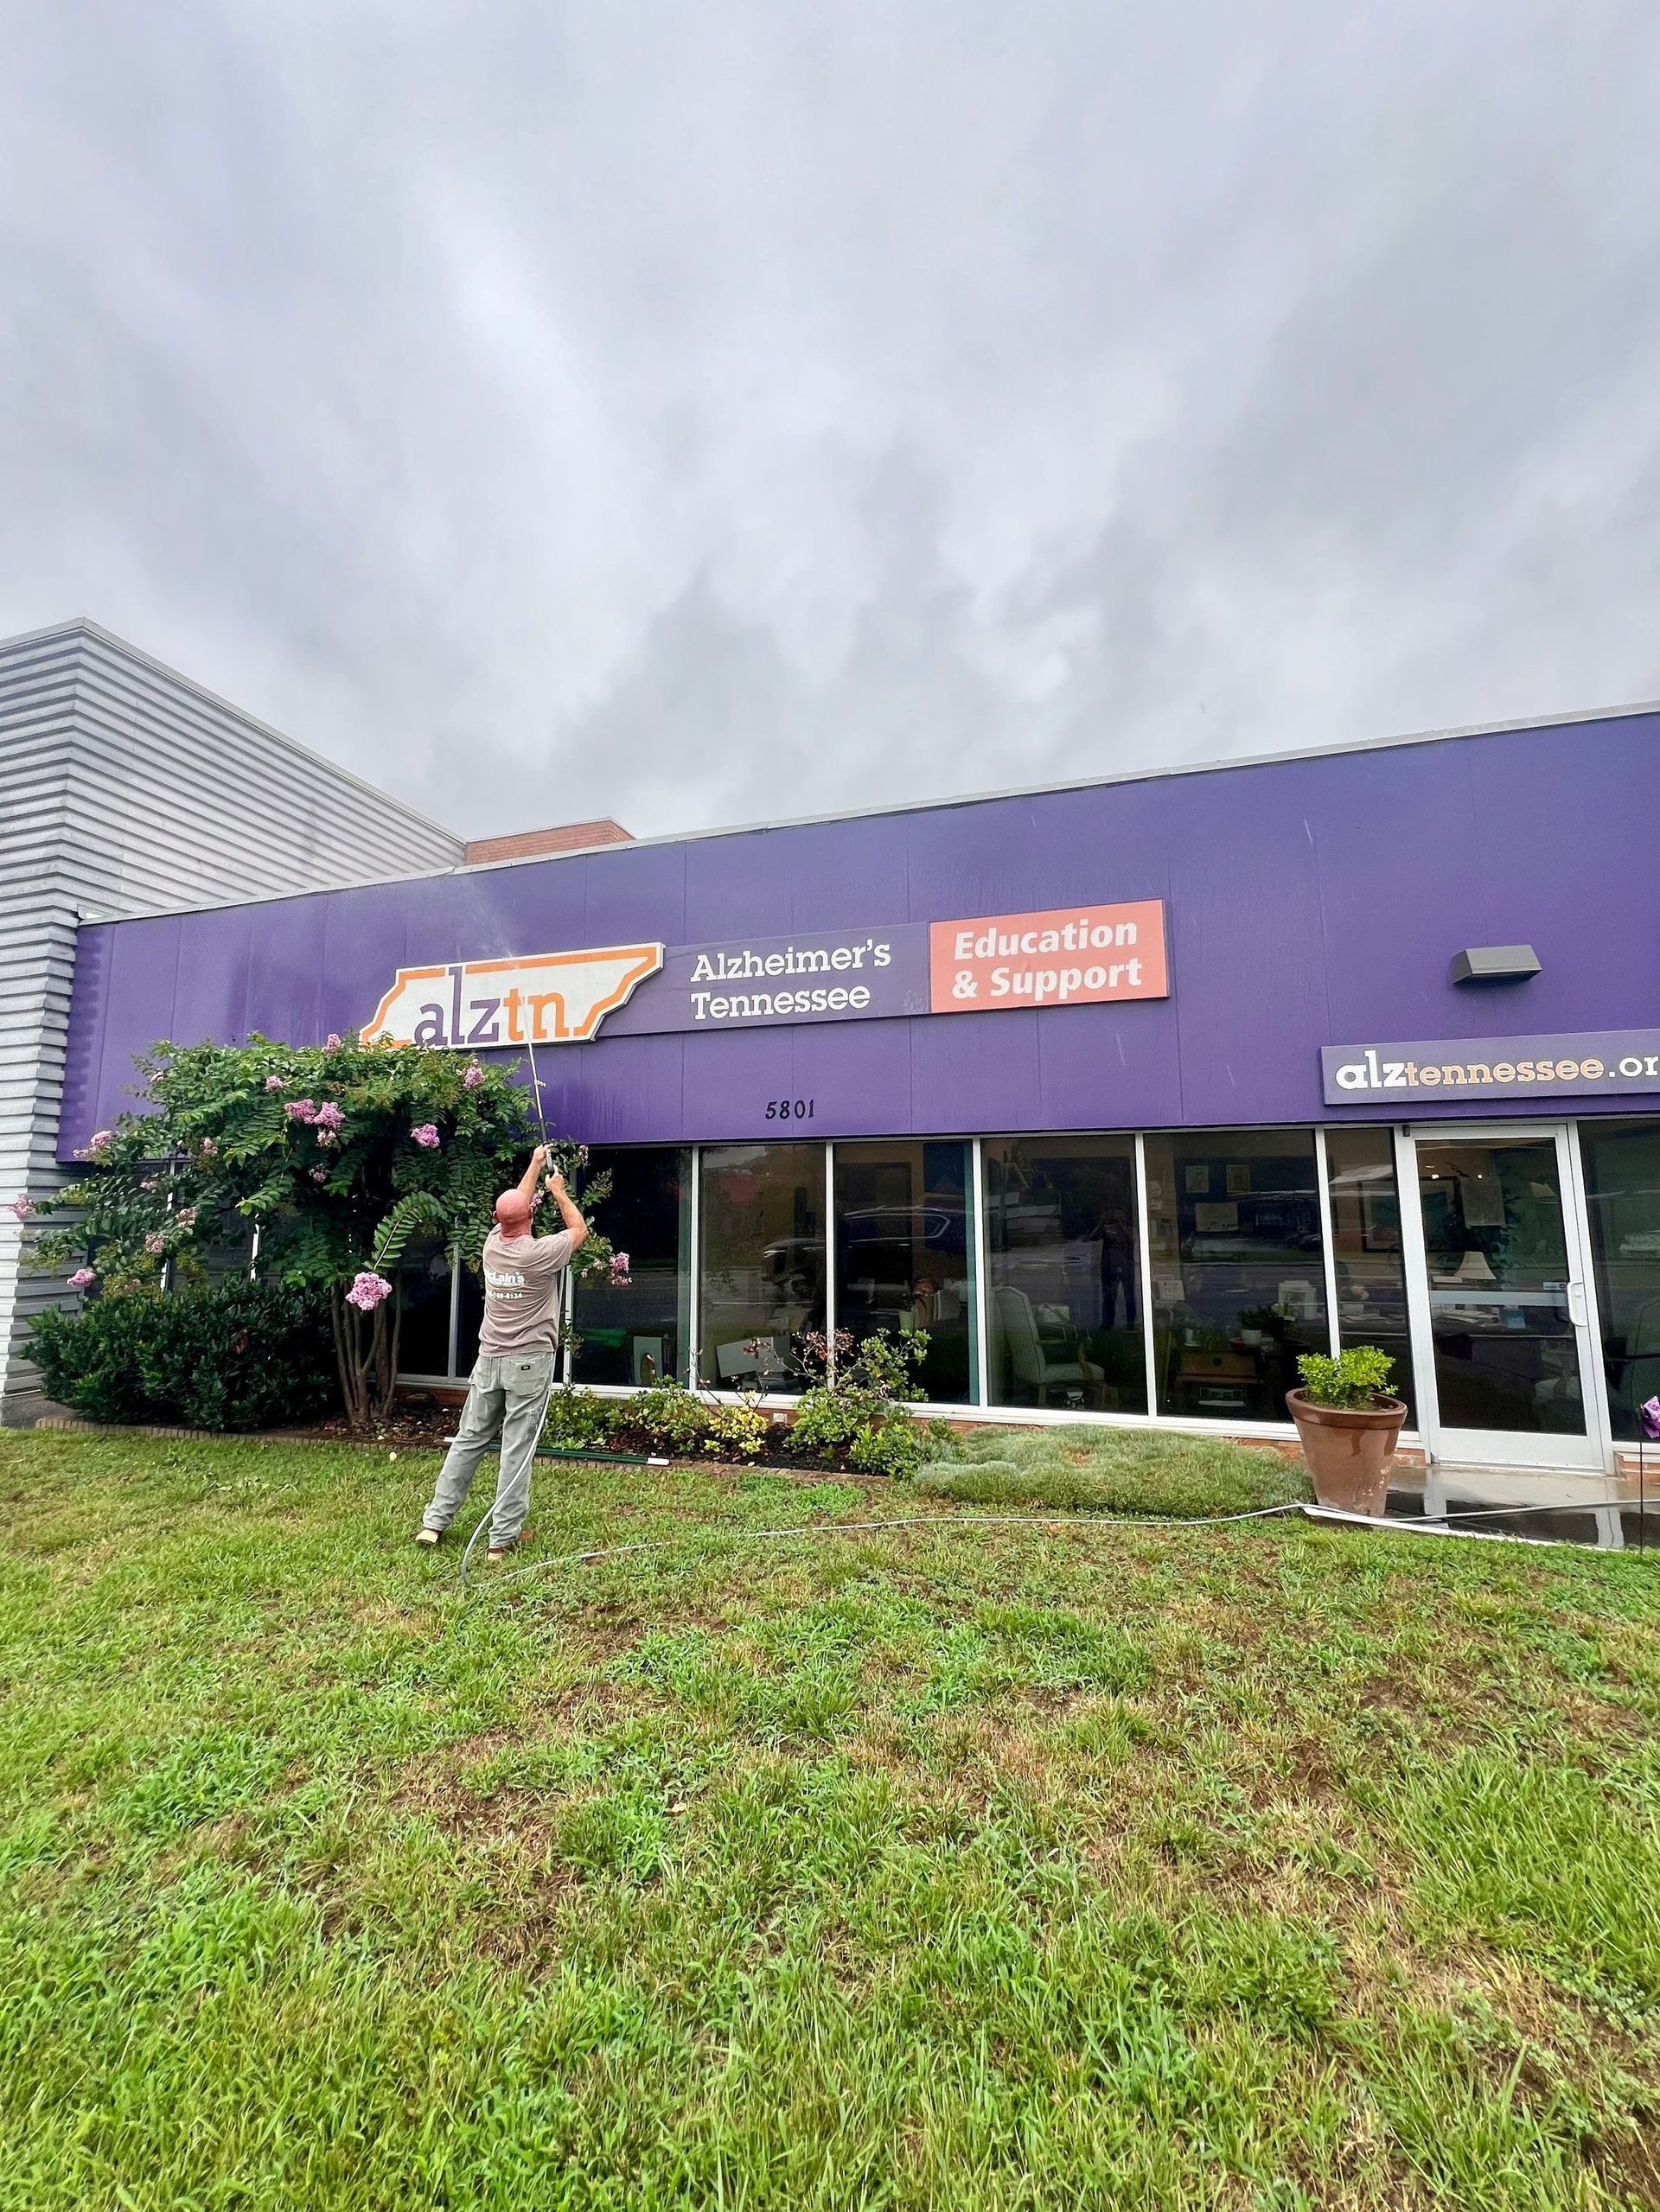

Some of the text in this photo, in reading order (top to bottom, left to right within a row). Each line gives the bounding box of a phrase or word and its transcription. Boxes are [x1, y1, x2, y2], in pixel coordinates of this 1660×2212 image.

[954, 919, 1138, 960] Education
[689, 939, 891, 983] Alzheimer's
[952, 957, 1143, 1001] & Support
[414, 966, 570, 1047] alztn
[690, 985, 872, 1021] Tennessee
[1335, 1049, 1659, 1090] alztennessee.or
[764, 1099, 815, 1120] 5801
